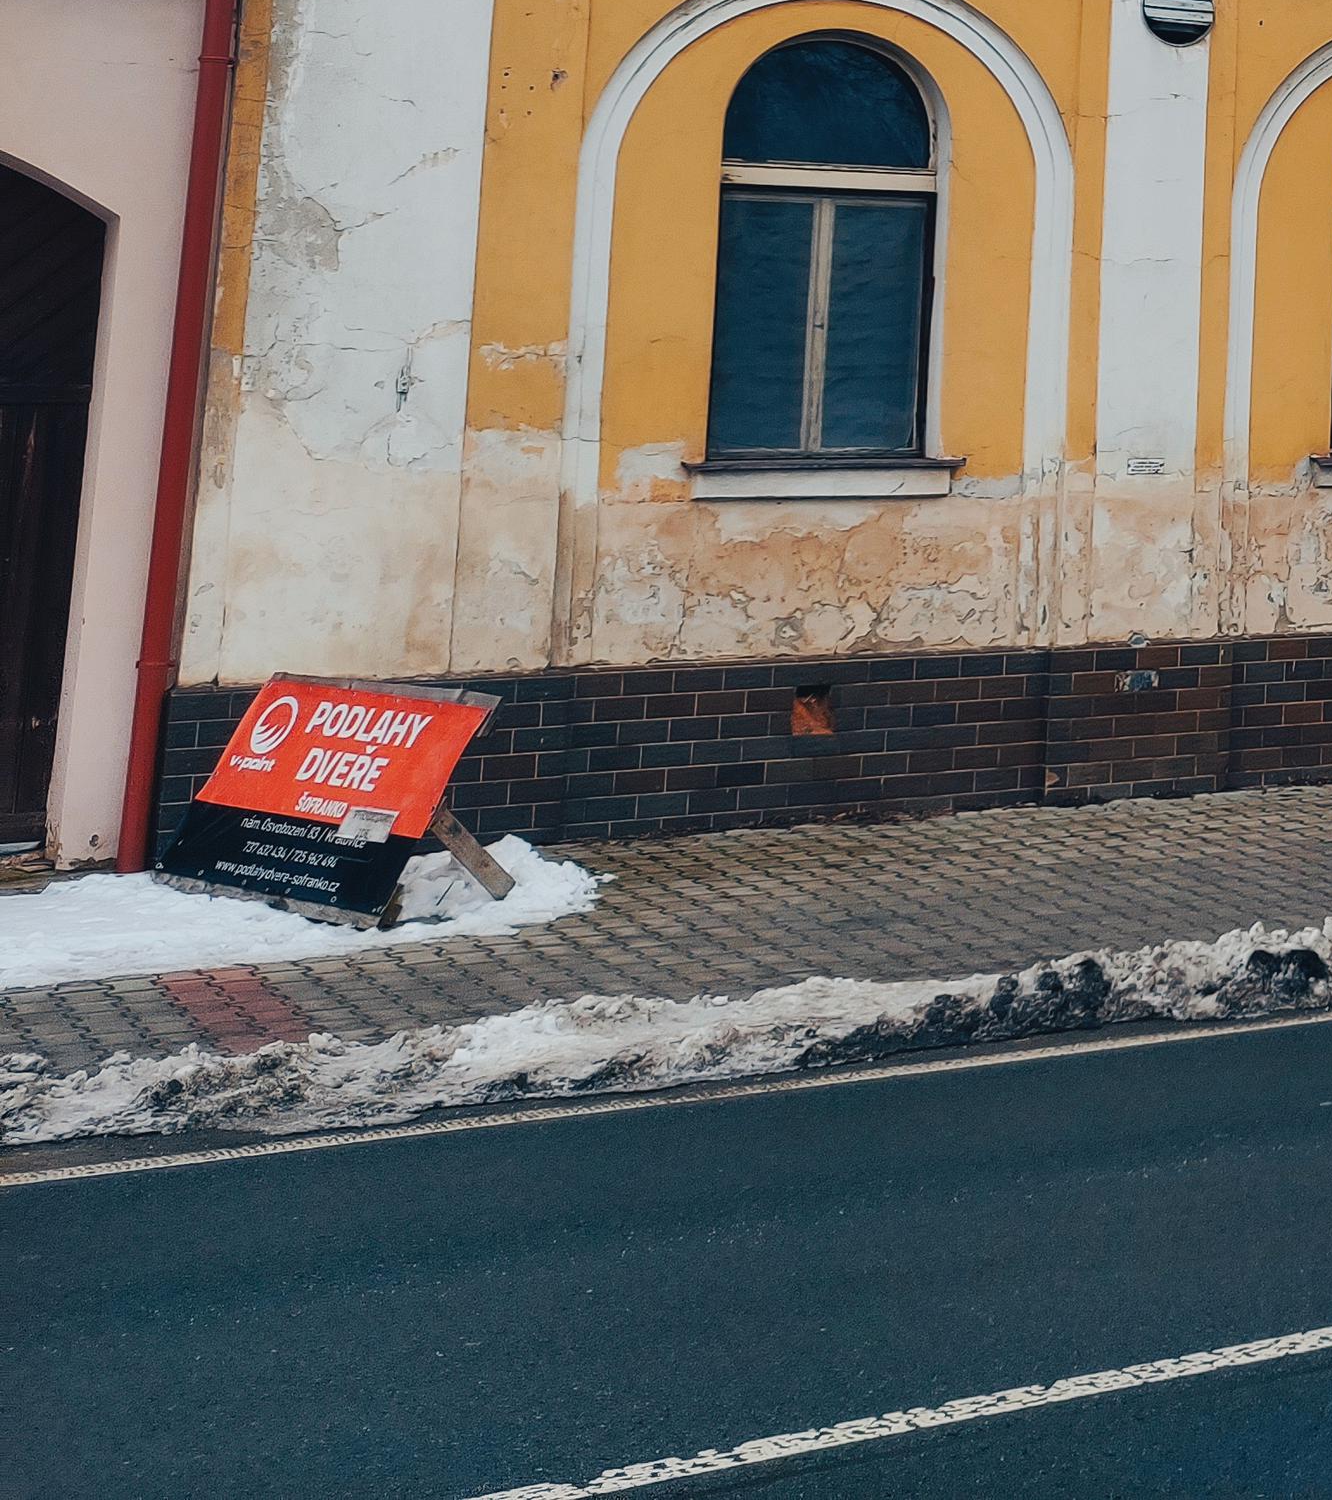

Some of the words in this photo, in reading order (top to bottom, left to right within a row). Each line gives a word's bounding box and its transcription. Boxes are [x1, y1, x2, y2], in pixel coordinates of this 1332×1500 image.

[305, 701, 432, 748] PODLAHY
[295, 745, 388, 792] DVEŘE
[295, 792, 348, 818] ŠOFRANKO
[260, 817, 310, 838] Osvobození
